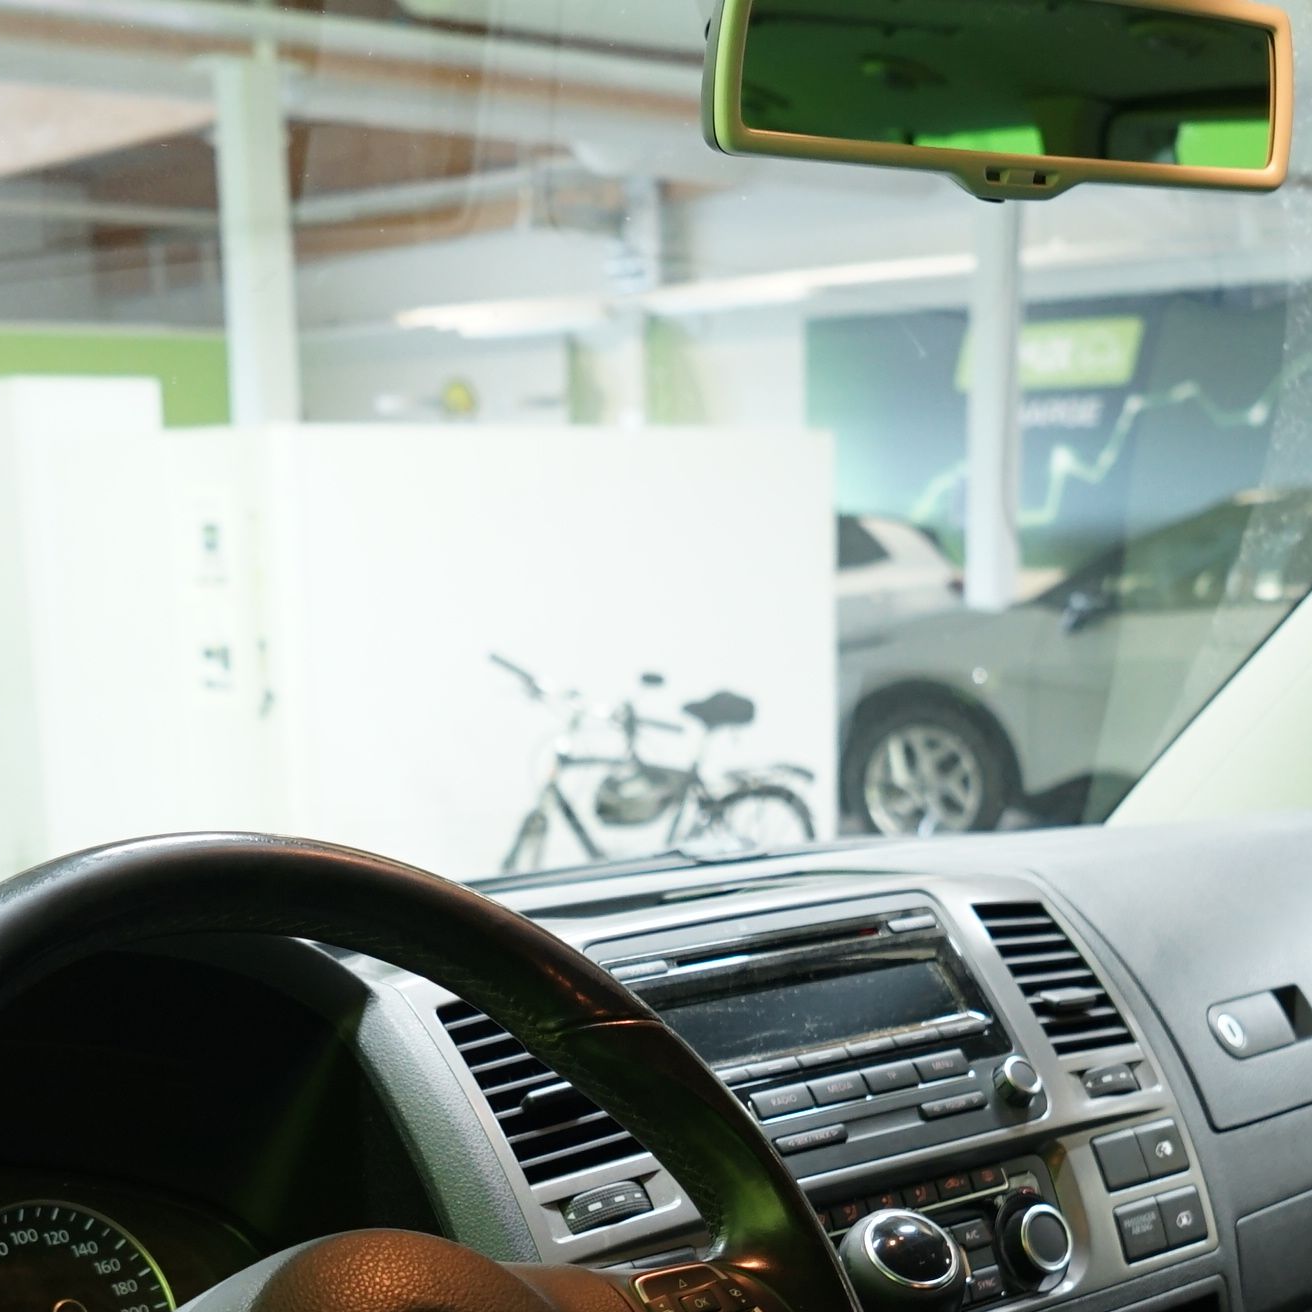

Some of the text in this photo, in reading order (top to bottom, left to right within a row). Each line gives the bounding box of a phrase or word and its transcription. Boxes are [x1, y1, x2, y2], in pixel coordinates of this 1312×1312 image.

[770, 1094, 798, 1106] RADIO
[10, 1228, 39, 1245] 100
[43, 1230, 70, 1246] 120
[965, 1229, 980, 1241] A/C
[71, 1240, 99, 1258] 140
[94, 1258, 121, 1275] 160
[111, 1279, 138, 1296] 180
[694, 1296, 710, 1309] OK
